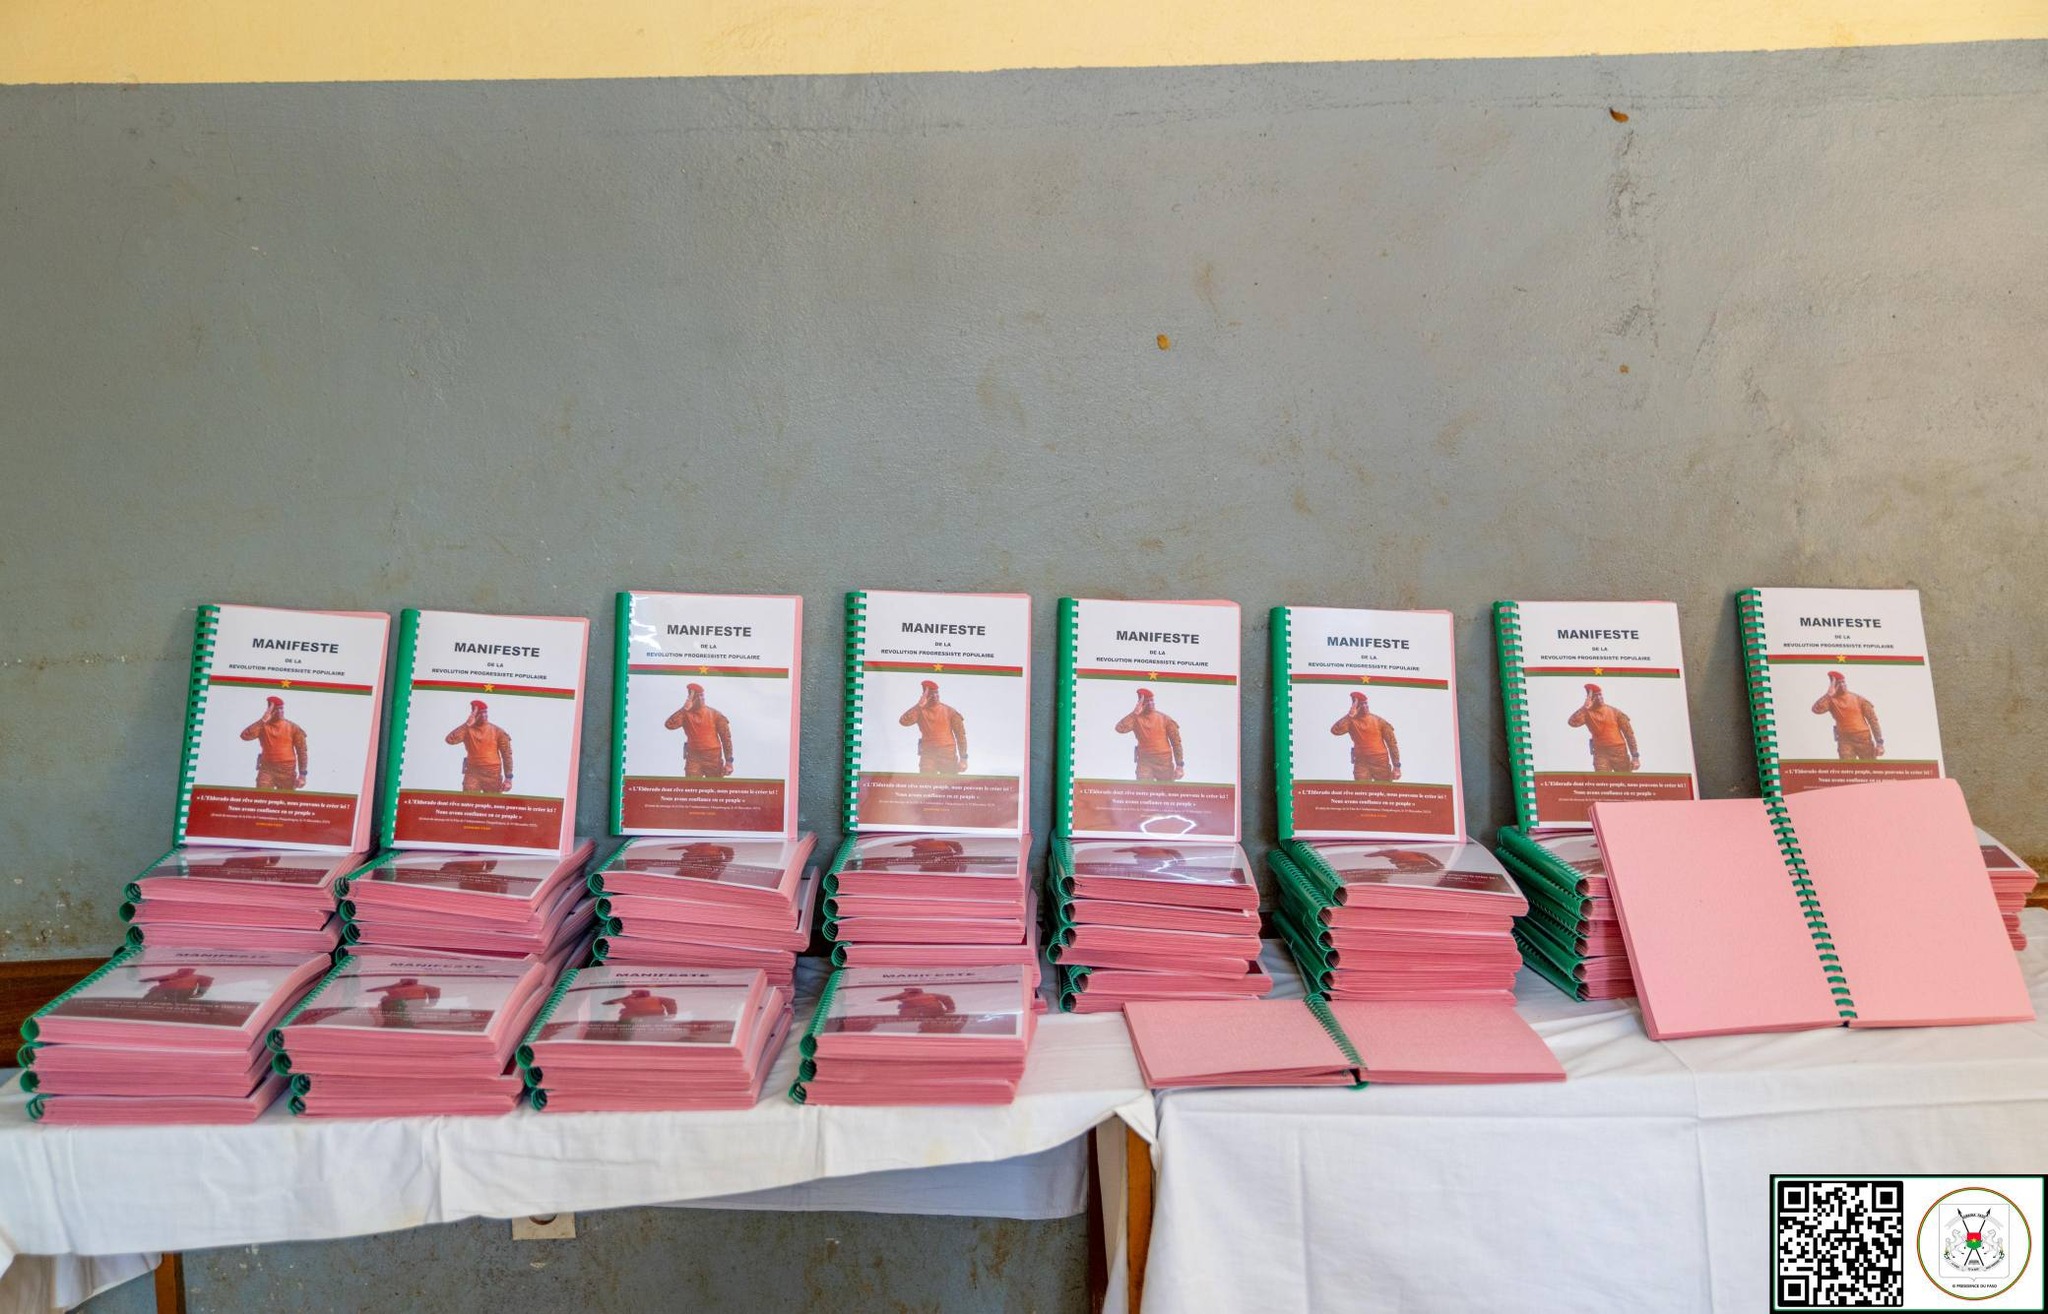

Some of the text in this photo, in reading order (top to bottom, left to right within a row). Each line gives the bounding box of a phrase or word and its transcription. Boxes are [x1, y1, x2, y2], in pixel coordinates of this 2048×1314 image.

[1800, 618, 1881, 627] MANIFESTE
[667, 625, 751, 637] MANIFESTE
[902, 623, 986, 635] MANIFESTE
[1558, 630, 1639, 639] MANIFESTE
[1116, 631, 1199, 644] MANIFESTE
[1327, 637, 1409, 649] MANIFESTE
[252, 638, 339, 653] MANIFESTE
[454, 642, 540, 657] MANIFESTE
